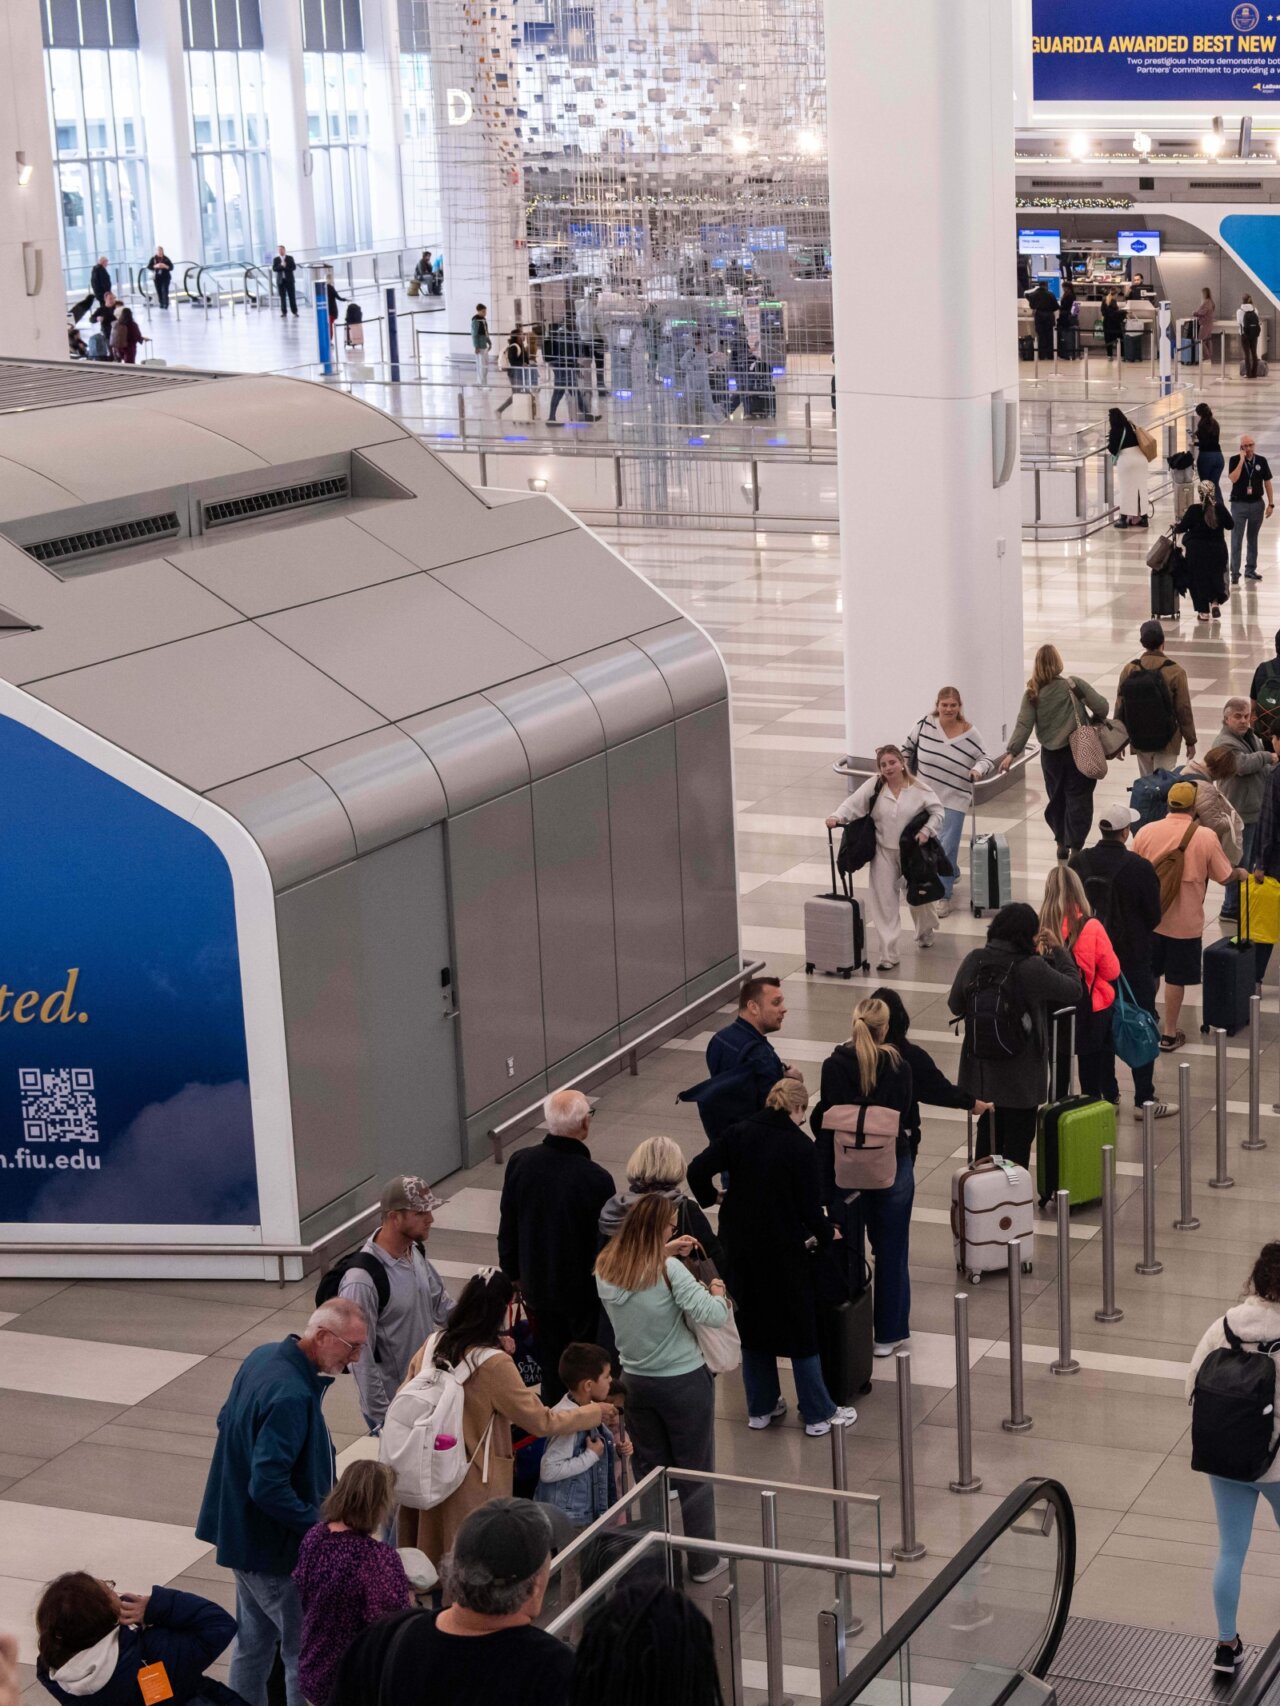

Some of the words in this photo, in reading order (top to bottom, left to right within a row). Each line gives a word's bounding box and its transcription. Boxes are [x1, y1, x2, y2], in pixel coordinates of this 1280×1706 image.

[1108, 35, 1188, 53] AWARDED
[1193, 35, 1234, 53] BEST
[1238, 35, 1277, 53] NEW
[1127, 57, 1143, 65] Two
[1144, 57, 1186, 66] prestigious
[1188, 57, 1215, 65] honors
[1216, 57, 1266, 65] demonstrate
[1172, 66, 1221, 74] commitment
[1223, 66, 1232, 74] to
[1233, 66, 1269, 76] providing
[446, 88, 473, 126] D
